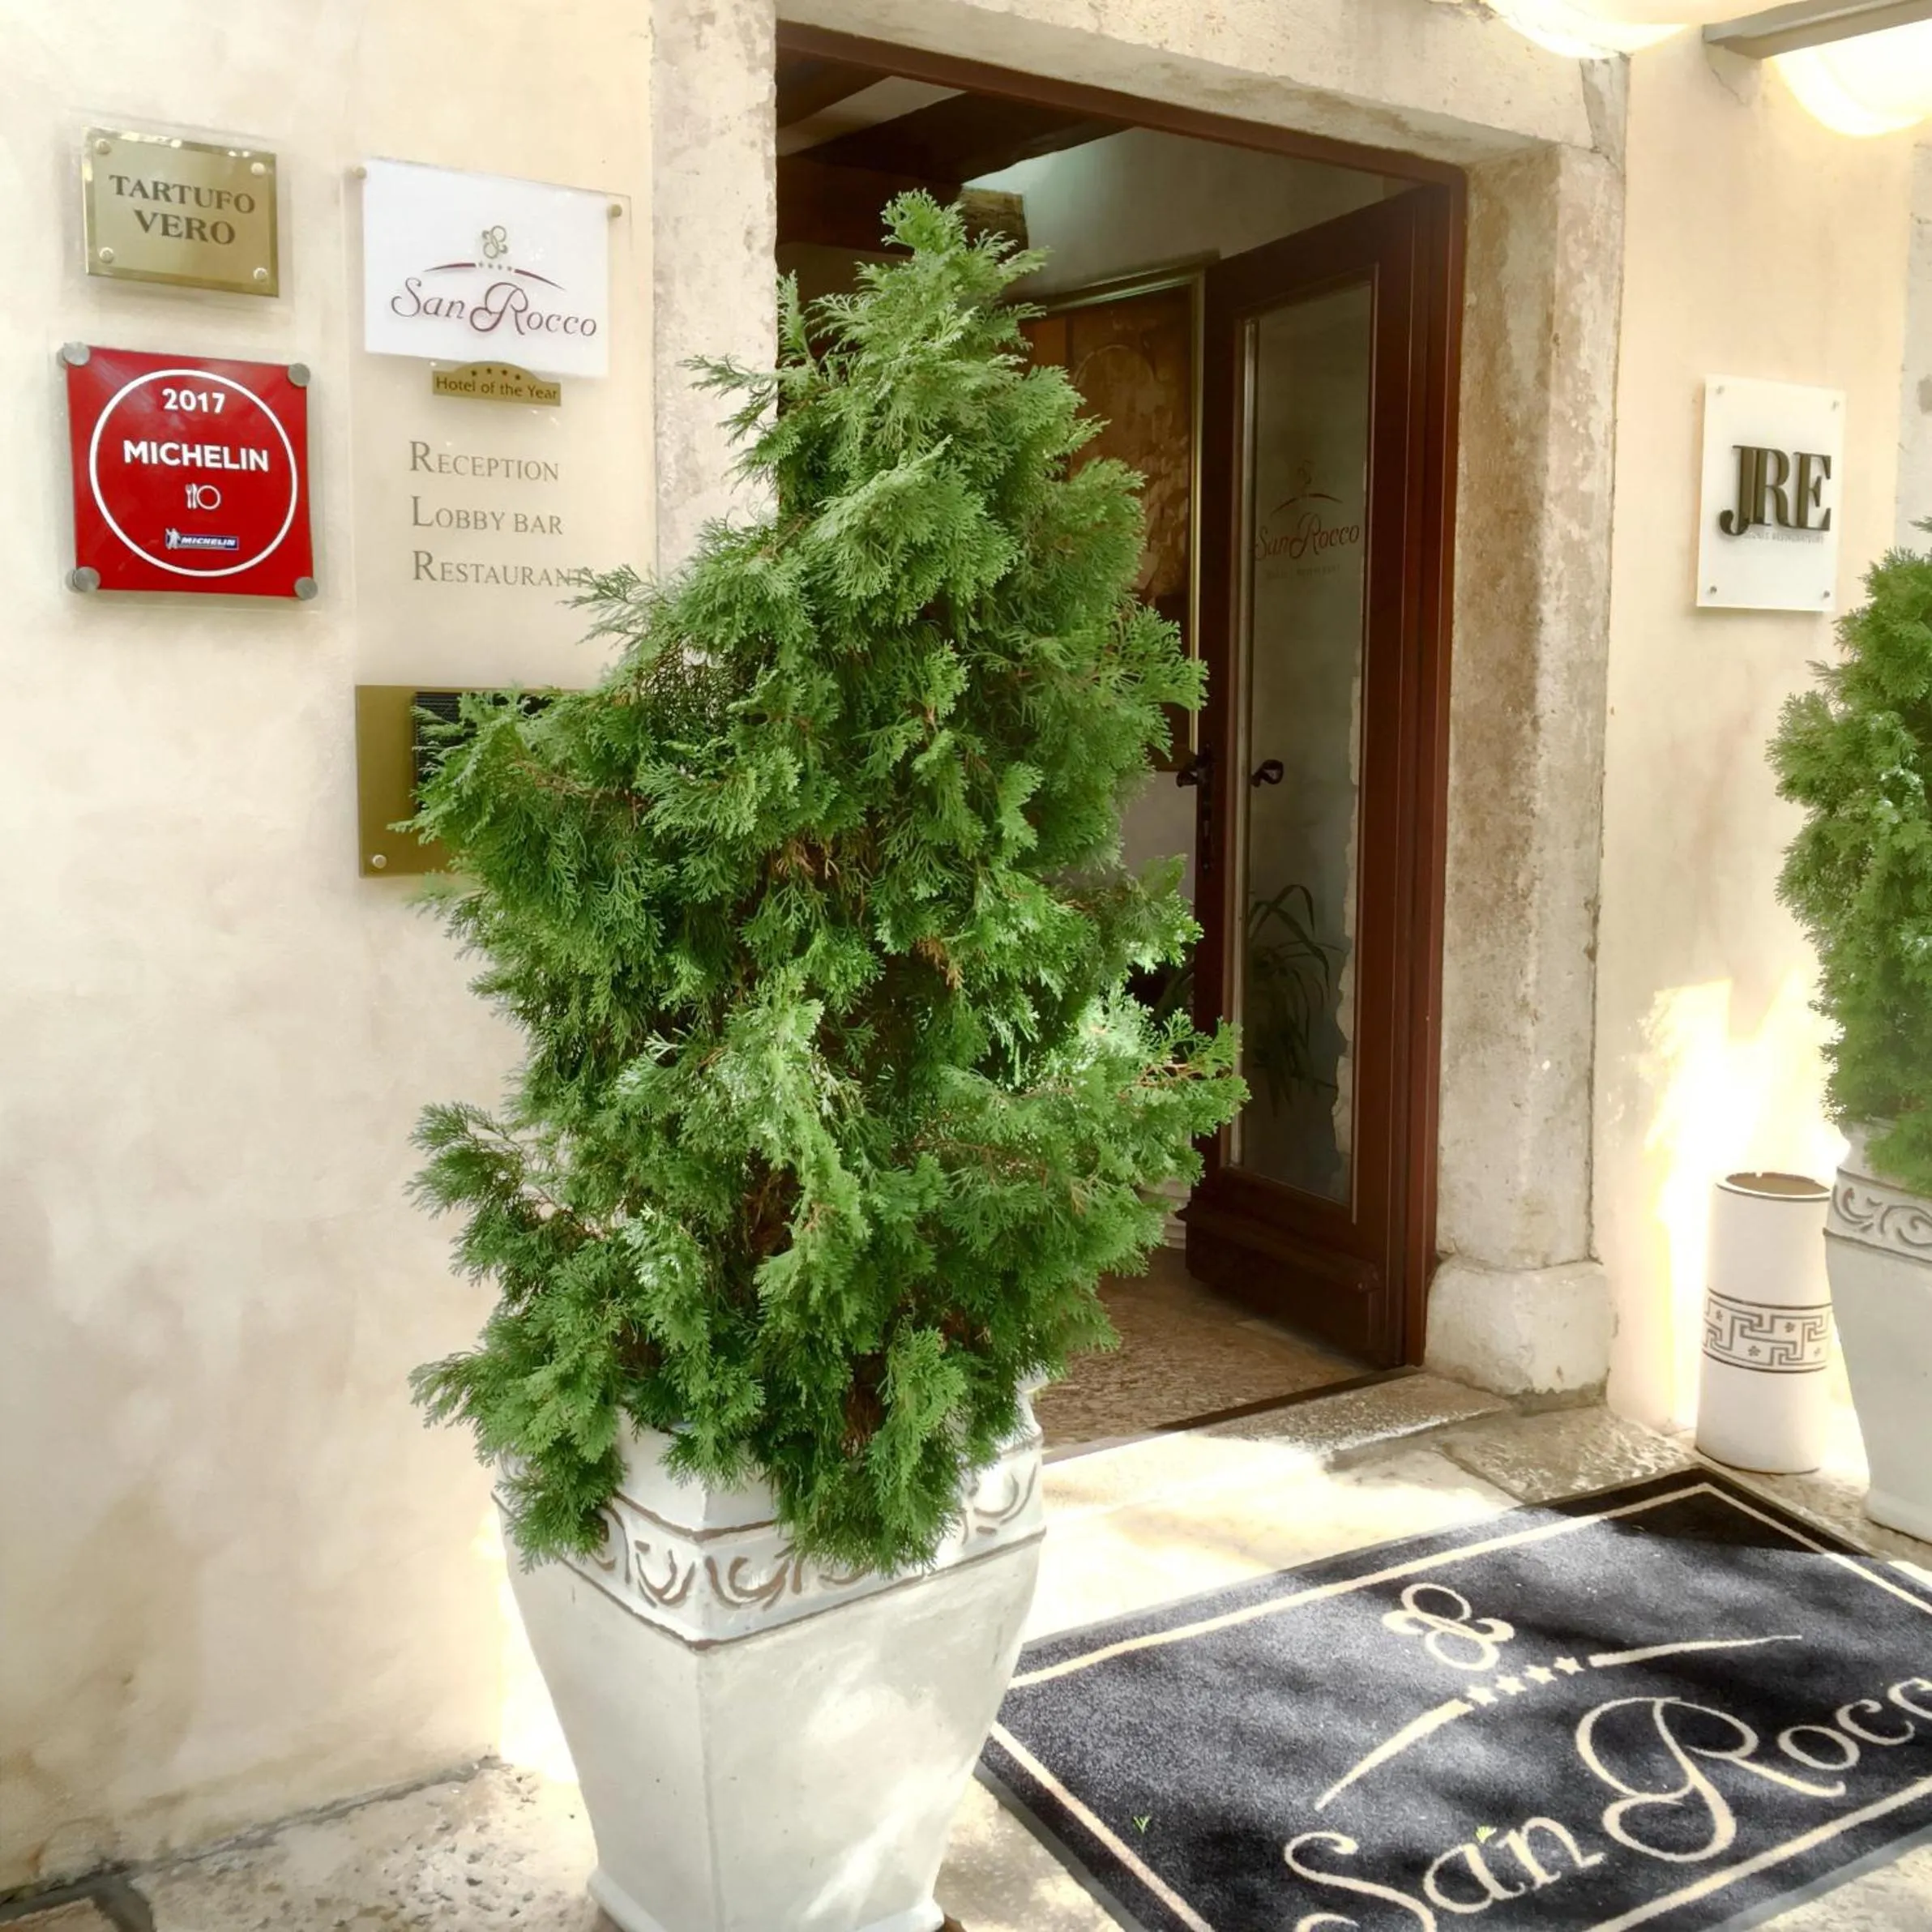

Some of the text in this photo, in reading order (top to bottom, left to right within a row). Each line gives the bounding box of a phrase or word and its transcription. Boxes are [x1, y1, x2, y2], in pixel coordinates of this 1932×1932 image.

[109, 174, 255, 214] TARTUFO
[134, 209, 236, 245] VERO
[391, 277, 597, 336] San Rocco
[162, 388, 225, 413] 2017
[436, 376, 558, 400] Hotel of the Year
[123, 440, 268, 472] MICHELIN
[409, 441, 559, 481] RECEPTION
[1719, 445, 1832, 536] JRE
[411, 496, 563, 535] LOBBY BAR
[181, 537, 236, 546] MICHELIN
[1289, 512, 1360, 559] Rocco
[1284, 1817, 1605, 1932] San
